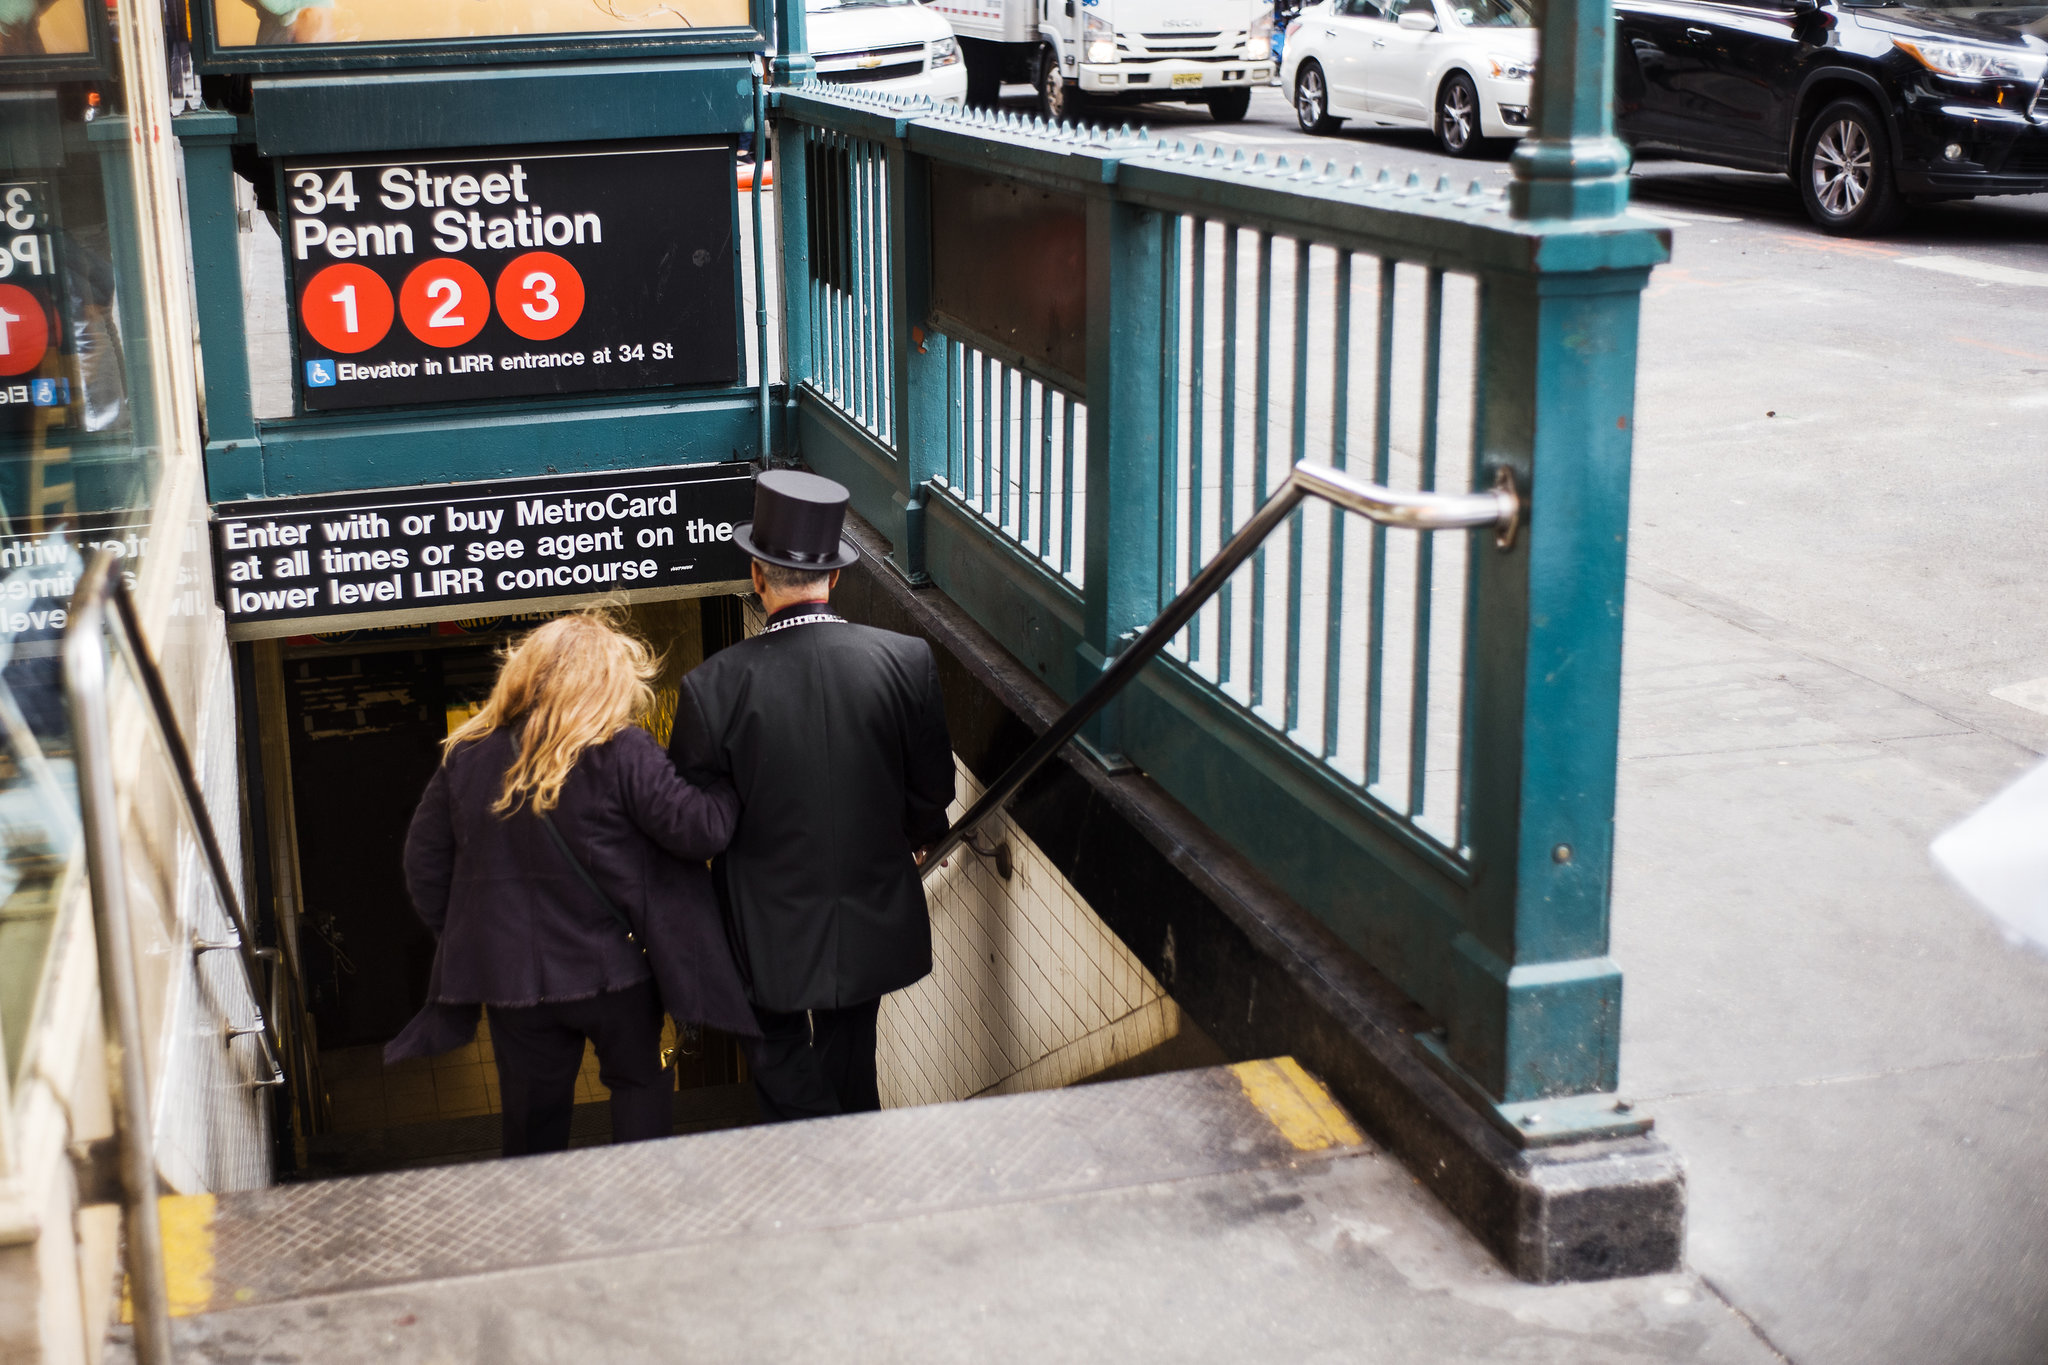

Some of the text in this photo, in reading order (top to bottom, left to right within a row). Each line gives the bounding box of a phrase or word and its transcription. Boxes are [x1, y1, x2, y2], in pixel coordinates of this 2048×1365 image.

[293, 163, 530, 216] 34 Street
[294, 205, 603, 260] Penn Station
[331, 271, 560, 333] 1 2 3
[338, 342, 674, 382] Elevator in LIRR entrance at 34 St
[226, 489, 677, 550] Enter with or buy MetroCard
[230, 518, 733, 582] at all times or see agent on the
[231, 558, 658, 614] lower level LIRR concourse
